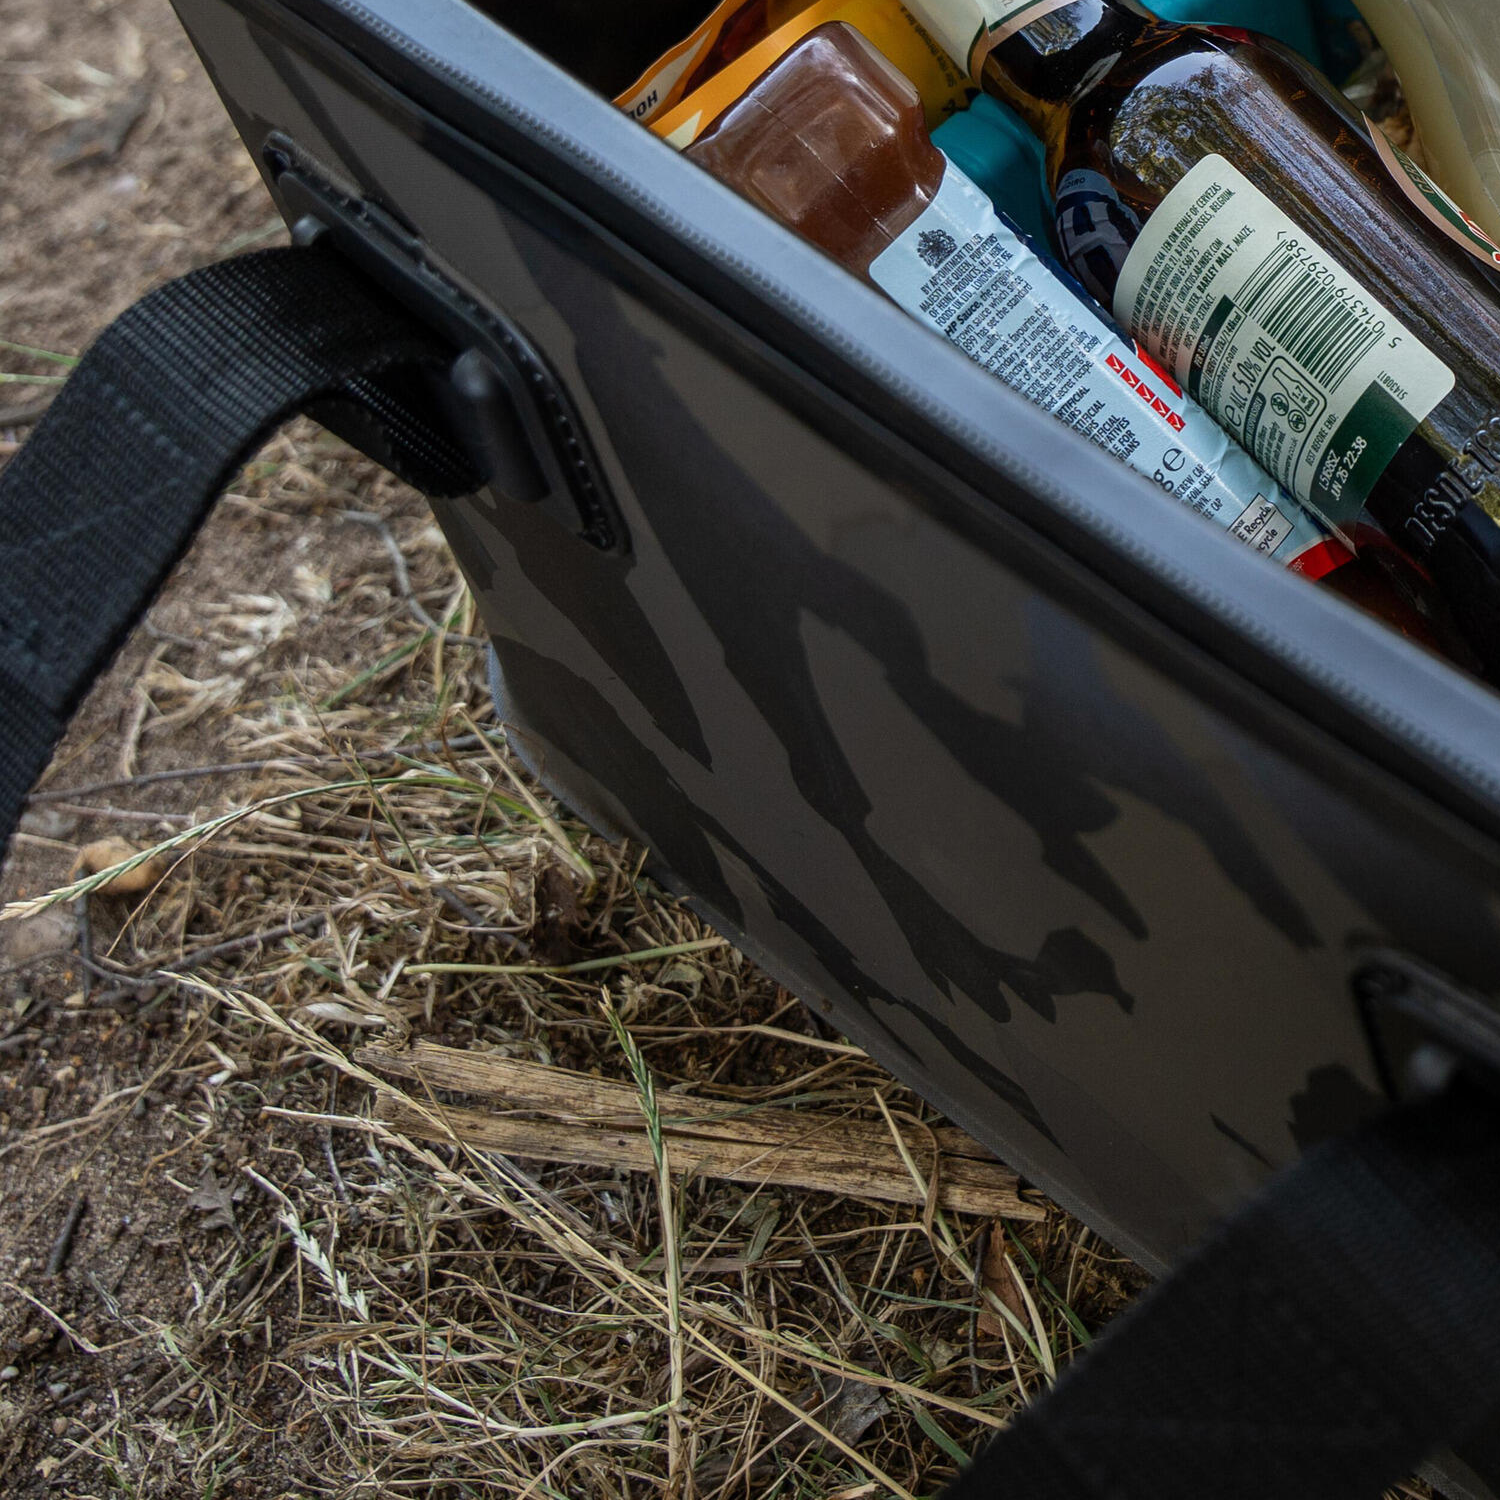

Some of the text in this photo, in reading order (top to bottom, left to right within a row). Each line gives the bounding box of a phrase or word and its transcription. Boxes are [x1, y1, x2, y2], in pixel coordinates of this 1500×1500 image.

[1186, 185, 1236, 240] BRUSSELS, BELGIUM.
[1188, 204, 1200, 217] OF
[1195, 180, 1222, 212] CERVEZAS
[1167, 230, 1180, 244] ON
[1173, 211, 1194, 236] BEHALF
[918, 258, 974, 313] MAJESTY THE QUEEN,
[920, 242, 974, 296] BY APPOINTMENT TO
[935, 264, 982, 311] HEINZ PRODUCTS,
[1183, 223, 1256, 315] WATER, BARLEY MALT, MAIZE,
[943, 268, 1015, 337] HP Sauce, the original
[971, 274, 1024, 327] sauce which since
[973, 280, 1033, 339] has set the standard
[1194, 292, 1217, 321] EXTRACT.
[1284, 238, 1402, 349] 5 014379 029758
[1007, 313, 1040, 343] favourite,
[1024, 325, 1060, 361] sauce is the
[1027, 314, 1055, 343] uniquely
[1039, 330, 1071, 363] dedication
[1227, 336, 1276, 412] ALC 5.0% VOL
[1376, 369, 1408, 401] 51430811
[1304, 412, 1338, 466] BEST BEFORE END:
[1335, 466, 1349, 484] 26
[1343, 435, 1368, 469] 22:38
[1242, 504, 1274, 536] Recycle
